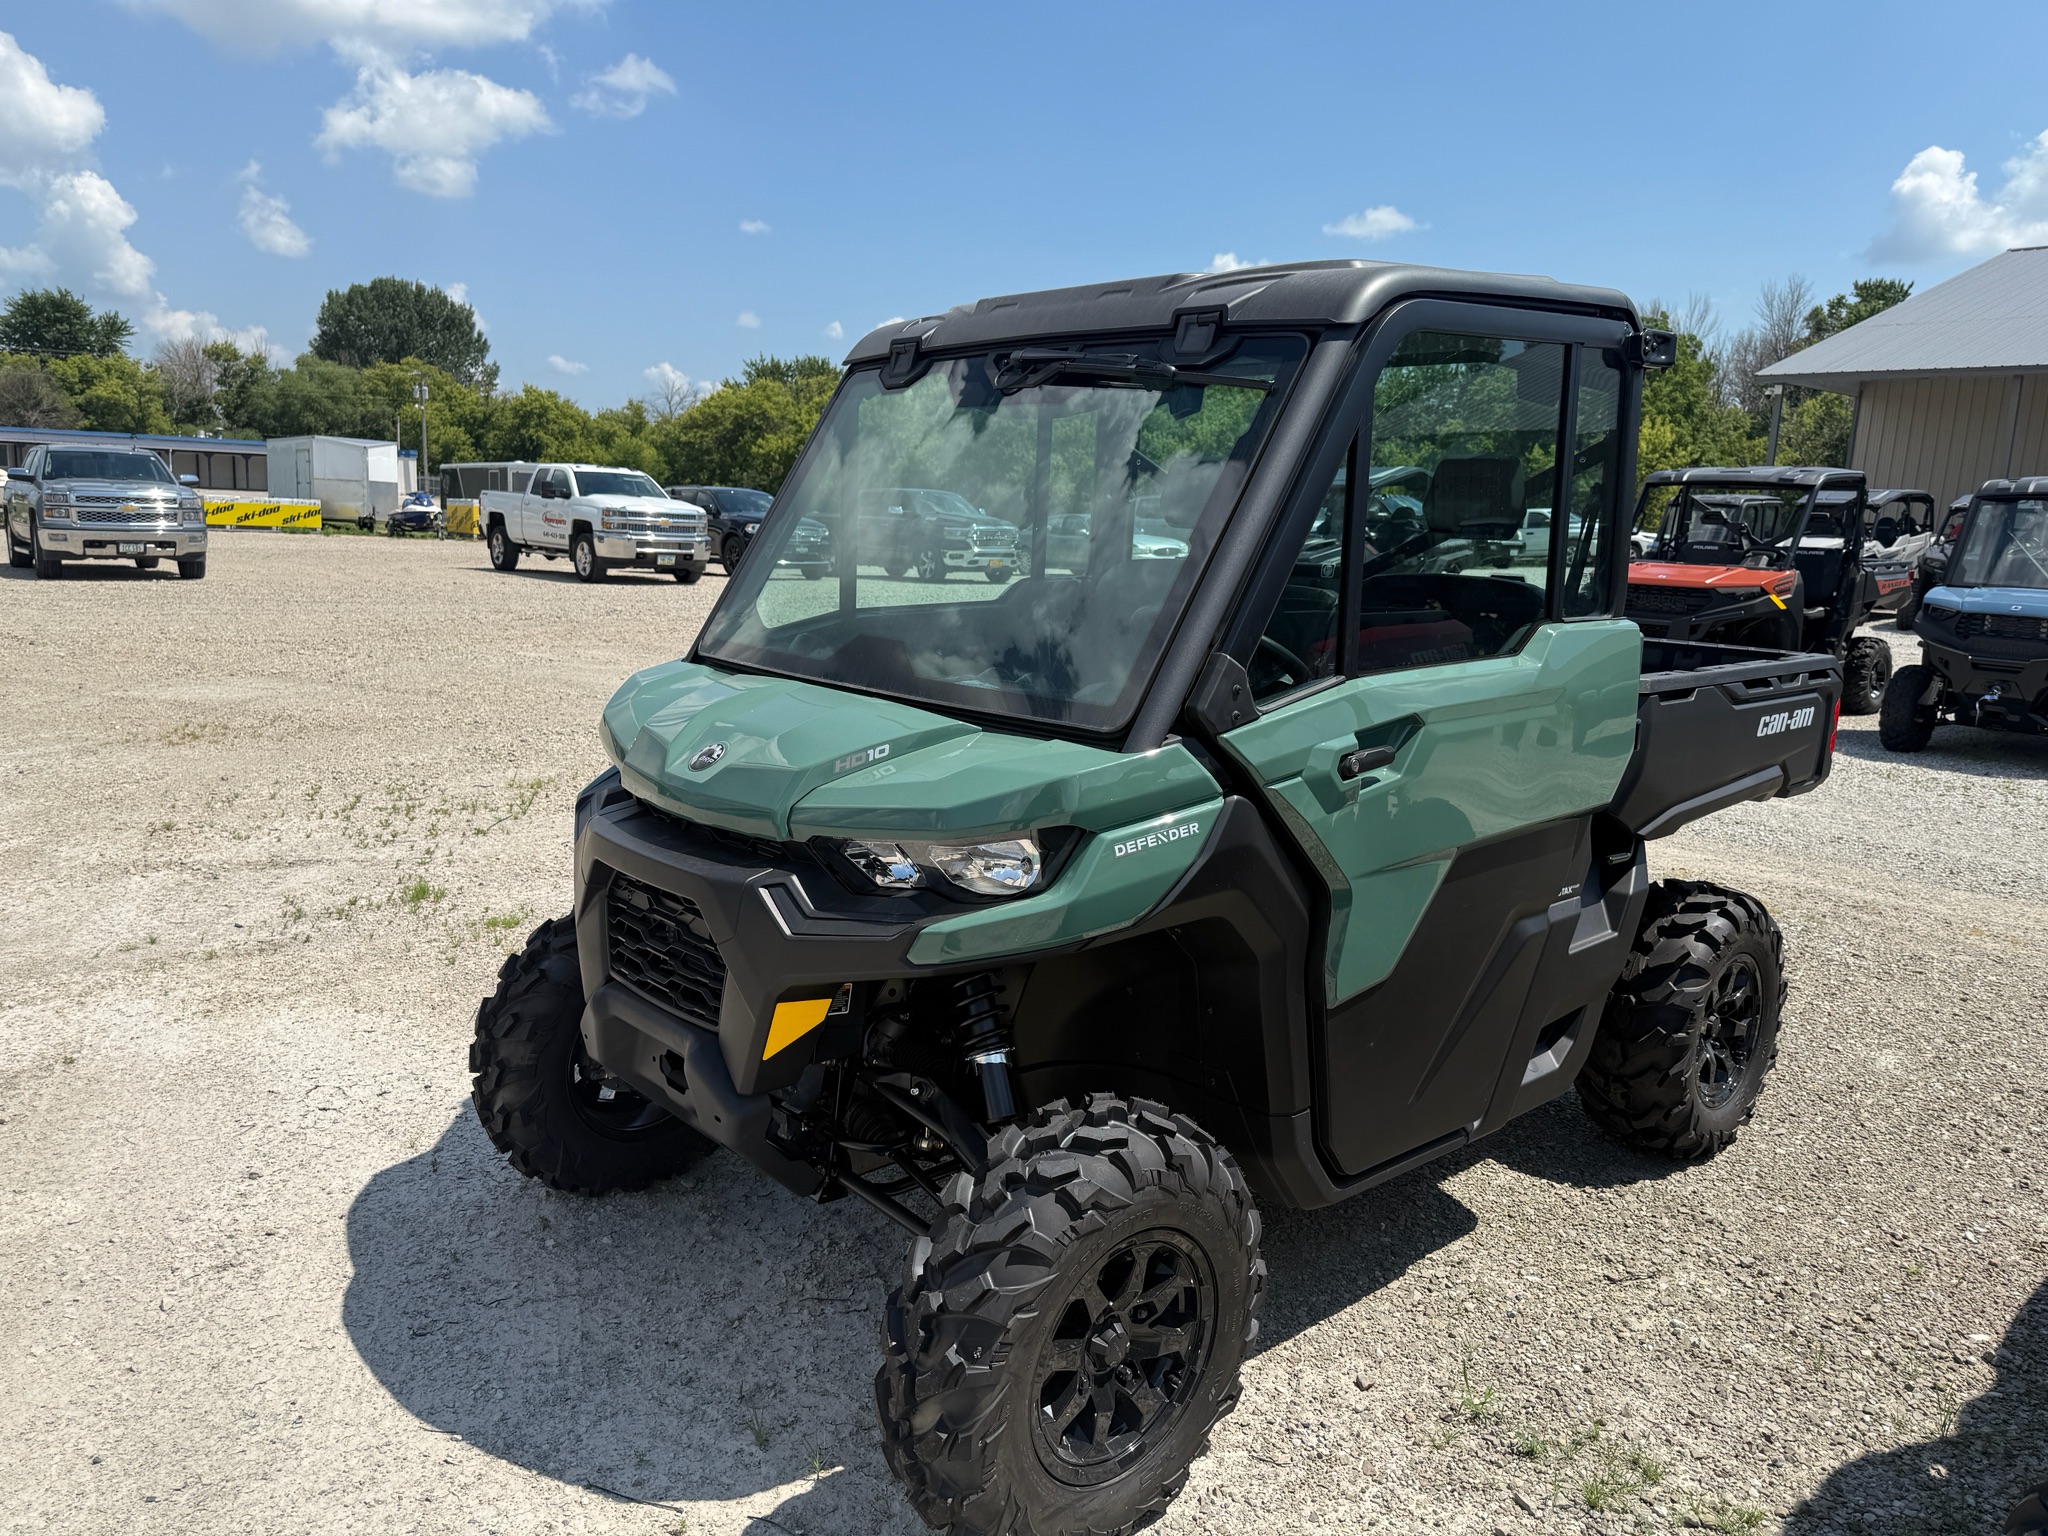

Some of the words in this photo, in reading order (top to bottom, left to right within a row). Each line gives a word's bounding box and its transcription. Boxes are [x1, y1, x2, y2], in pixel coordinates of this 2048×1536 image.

[205, 503, 234, 518] i-doo
[236, 505, 281, 524] ski-doo
[1881, 579, 1908, 590] RANGER
[1756, 706, 1815, 738] can-am
[835, 743, 890, 773] HD10
[1114, 822, 1200, 857] DEFENDER
